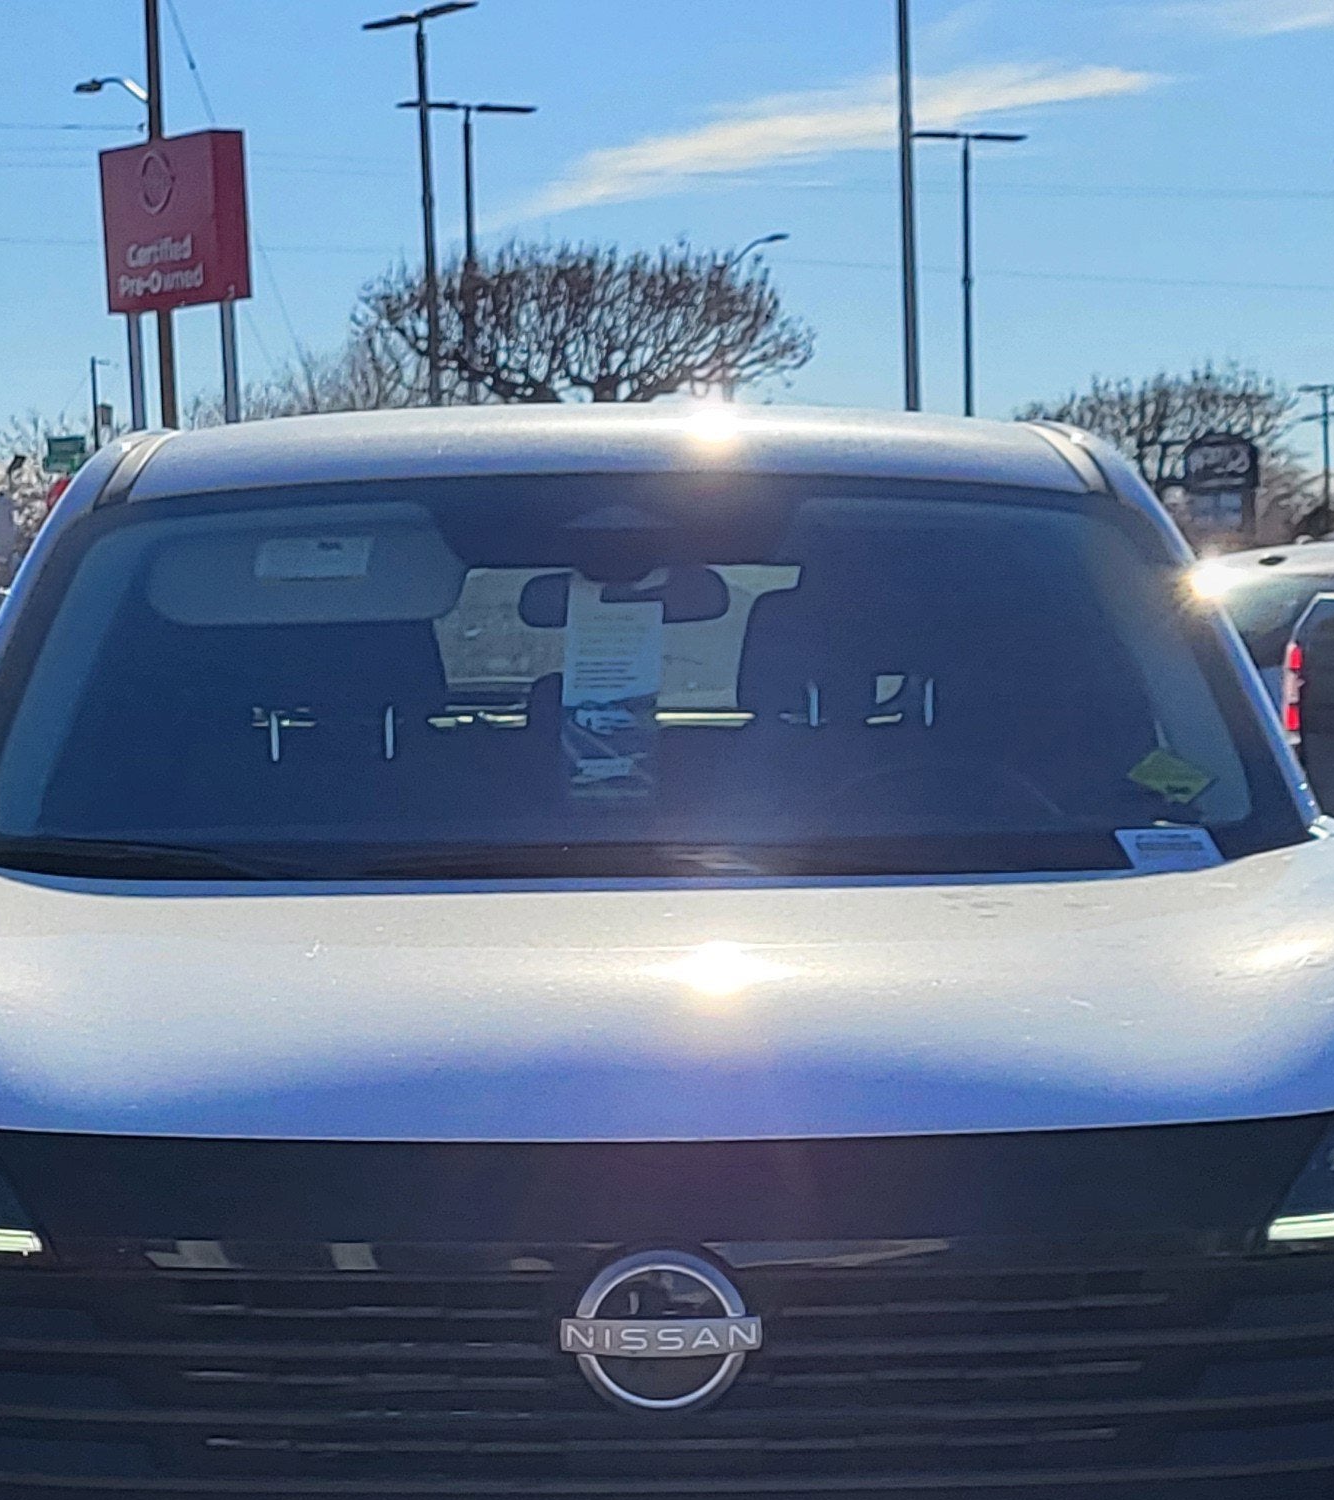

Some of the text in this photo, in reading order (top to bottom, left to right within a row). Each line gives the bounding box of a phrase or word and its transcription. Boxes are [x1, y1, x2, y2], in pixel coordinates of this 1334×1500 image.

[126, 232, 193, 269] Certified
[119, 262, 205, 298] Pre-Owned
[567, 1323, 757, 1350] NISSAN
